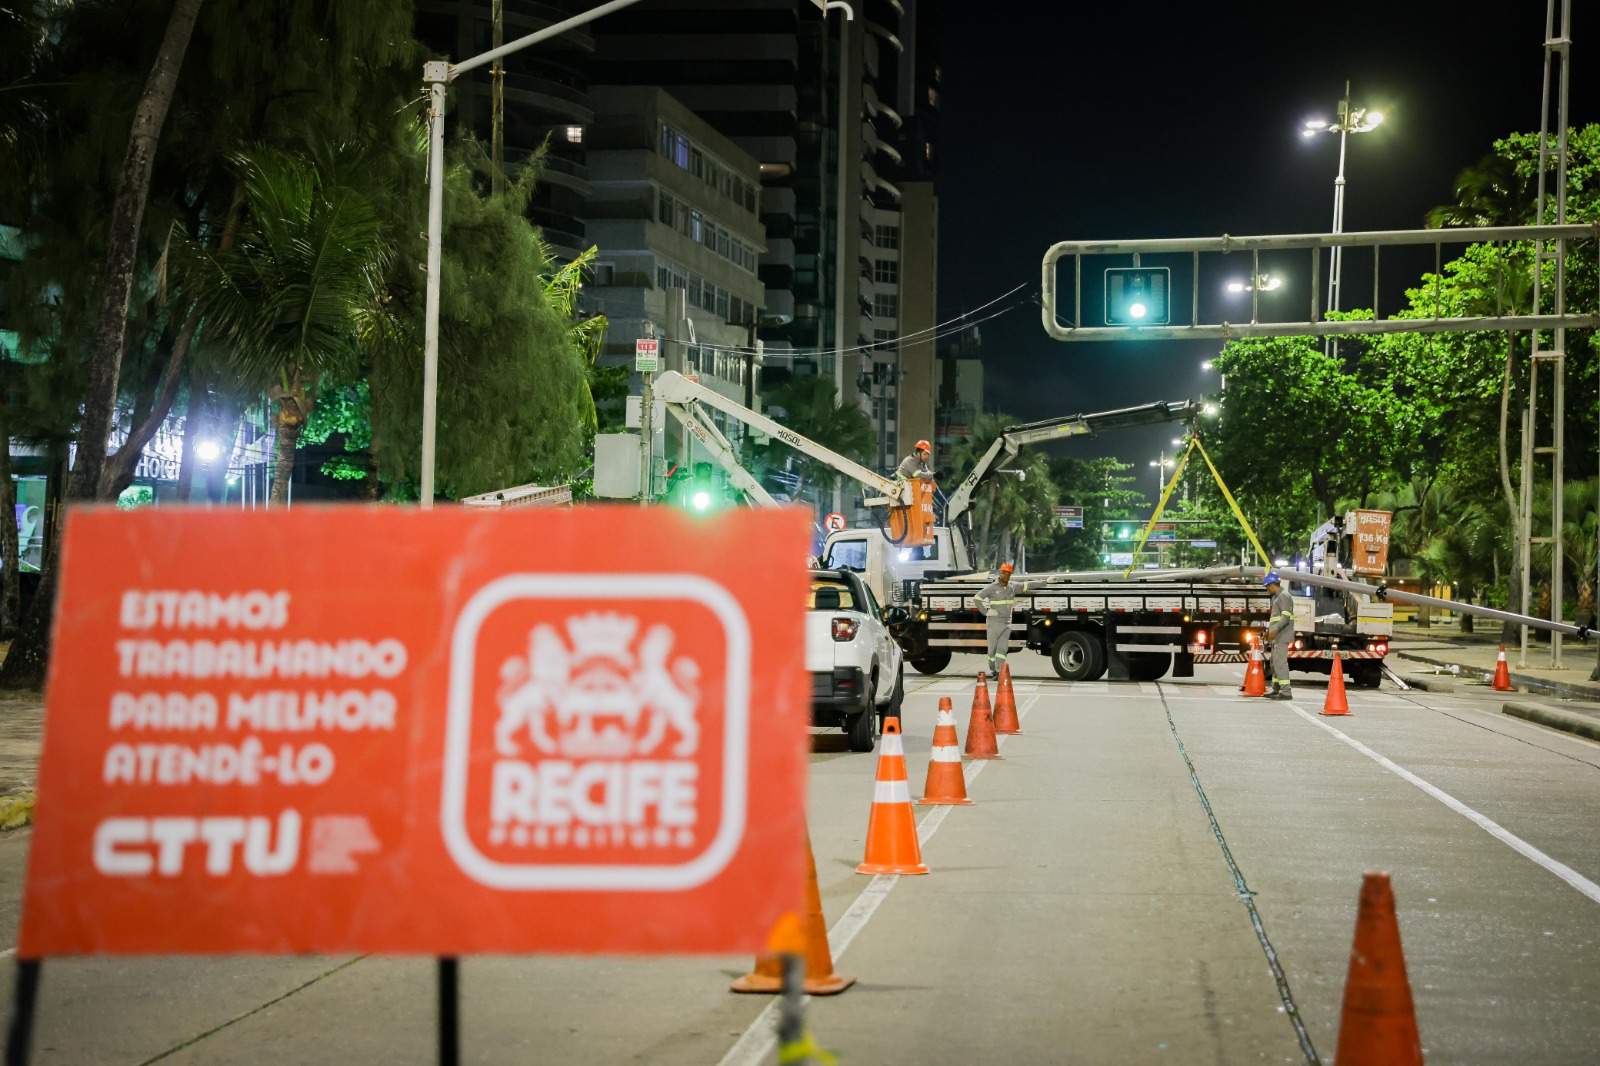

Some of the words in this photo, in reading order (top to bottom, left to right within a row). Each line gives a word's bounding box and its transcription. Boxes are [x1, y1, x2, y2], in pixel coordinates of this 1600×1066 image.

[1359, 533, 1374, 543] 136
[120, 591, 289, 628] ESTAMOS
[117, 639, 407, 678] TRABALHANDO
[109, 692, 218, 730] PARA
[226, 690, 397, 731] MELHOR
[104, 736, 335, 785] ATENDÊ-LO
[491, 760, 698, 824] RECIFE
